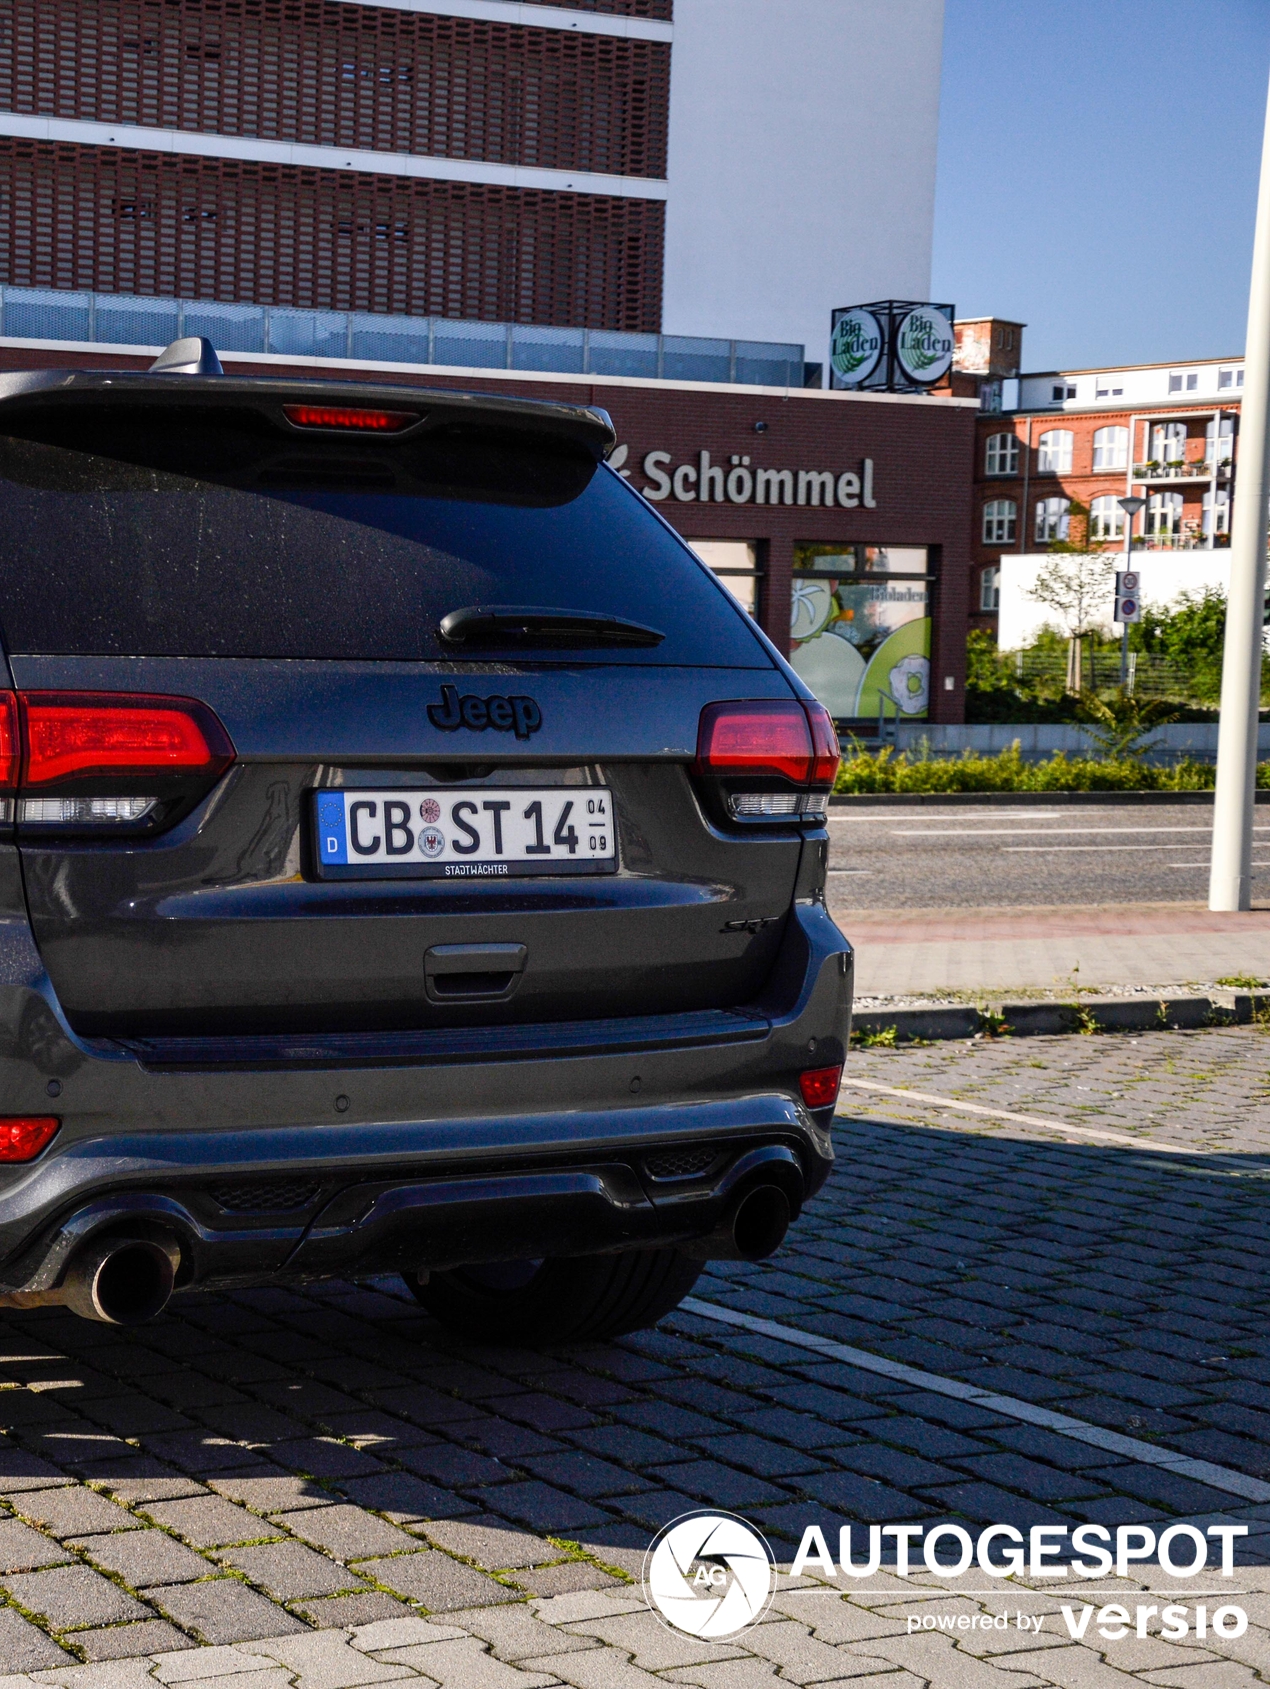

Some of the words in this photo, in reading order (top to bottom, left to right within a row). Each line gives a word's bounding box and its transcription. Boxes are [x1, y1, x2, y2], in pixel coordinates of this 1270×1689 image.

[840, 320, 862, 338] Bio
[910, 315, 933, 332] Bio
[832, 336, 878, 356] Laden
[900, 331, 951, 352] Laden
[642, 450, 877, 508] Schömmel
[426, 684, 542, 741] Jeep
[587, 798, 607, 816] 04
[348, 800, 415, 856] CB
[451, 799, 511, 854] ST
[523, 800, 579, 854] 14
[326, 837, 338, 853] D
[589, 835, 607, 851] 09
